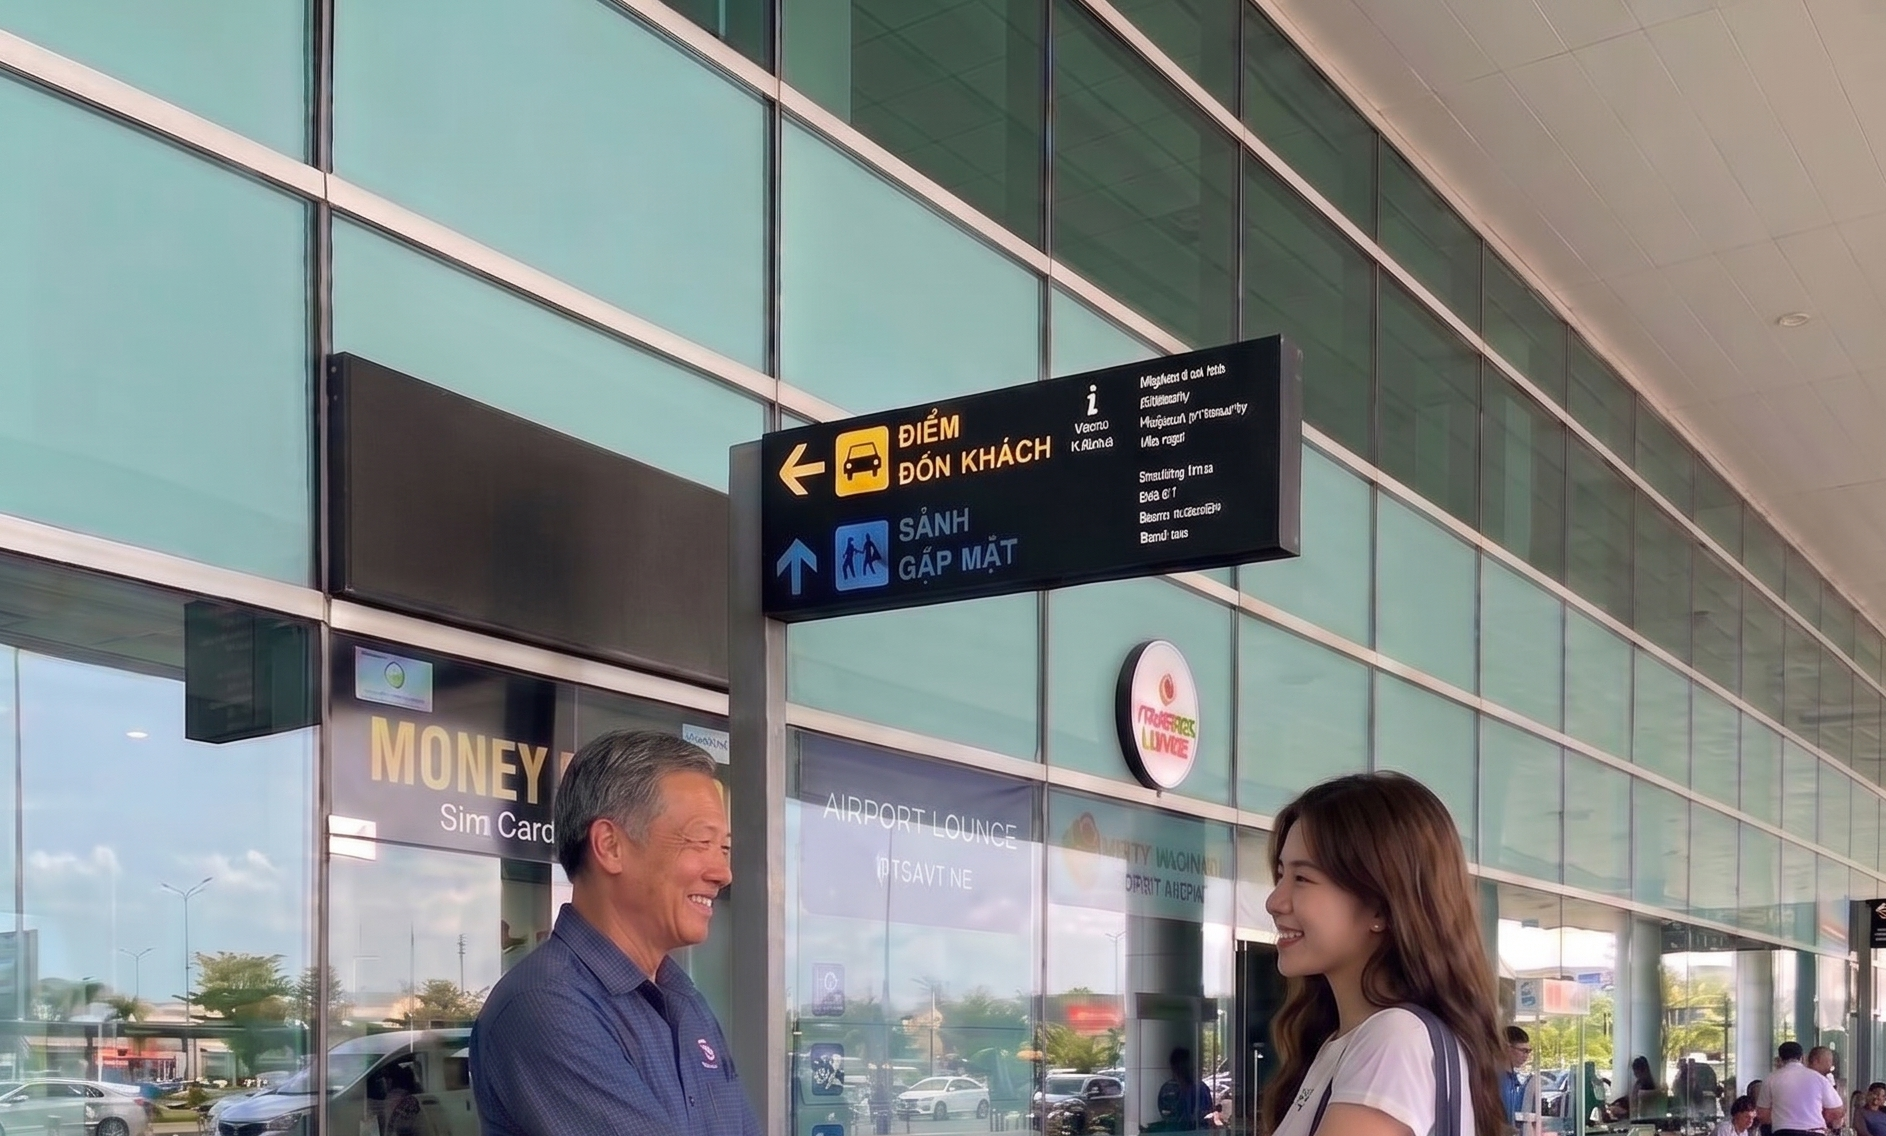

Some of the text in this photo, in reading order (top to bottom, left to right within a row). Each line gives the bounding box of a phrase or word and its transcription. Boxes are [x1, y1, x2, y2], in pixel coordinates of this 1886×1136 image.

[898, 408, 960, 448] ĐIỂM
[898, 435, 1051, 485] ĐÓN KHÁCH
[899, 506, 969, 542] SẢNH
[961, 534, 1018, 574] MẶT
[371, 716, 549, 804] MONEY
[440, 803, 555, 844] Sim Card
[823, 792, 926, 834] AIRPORT
